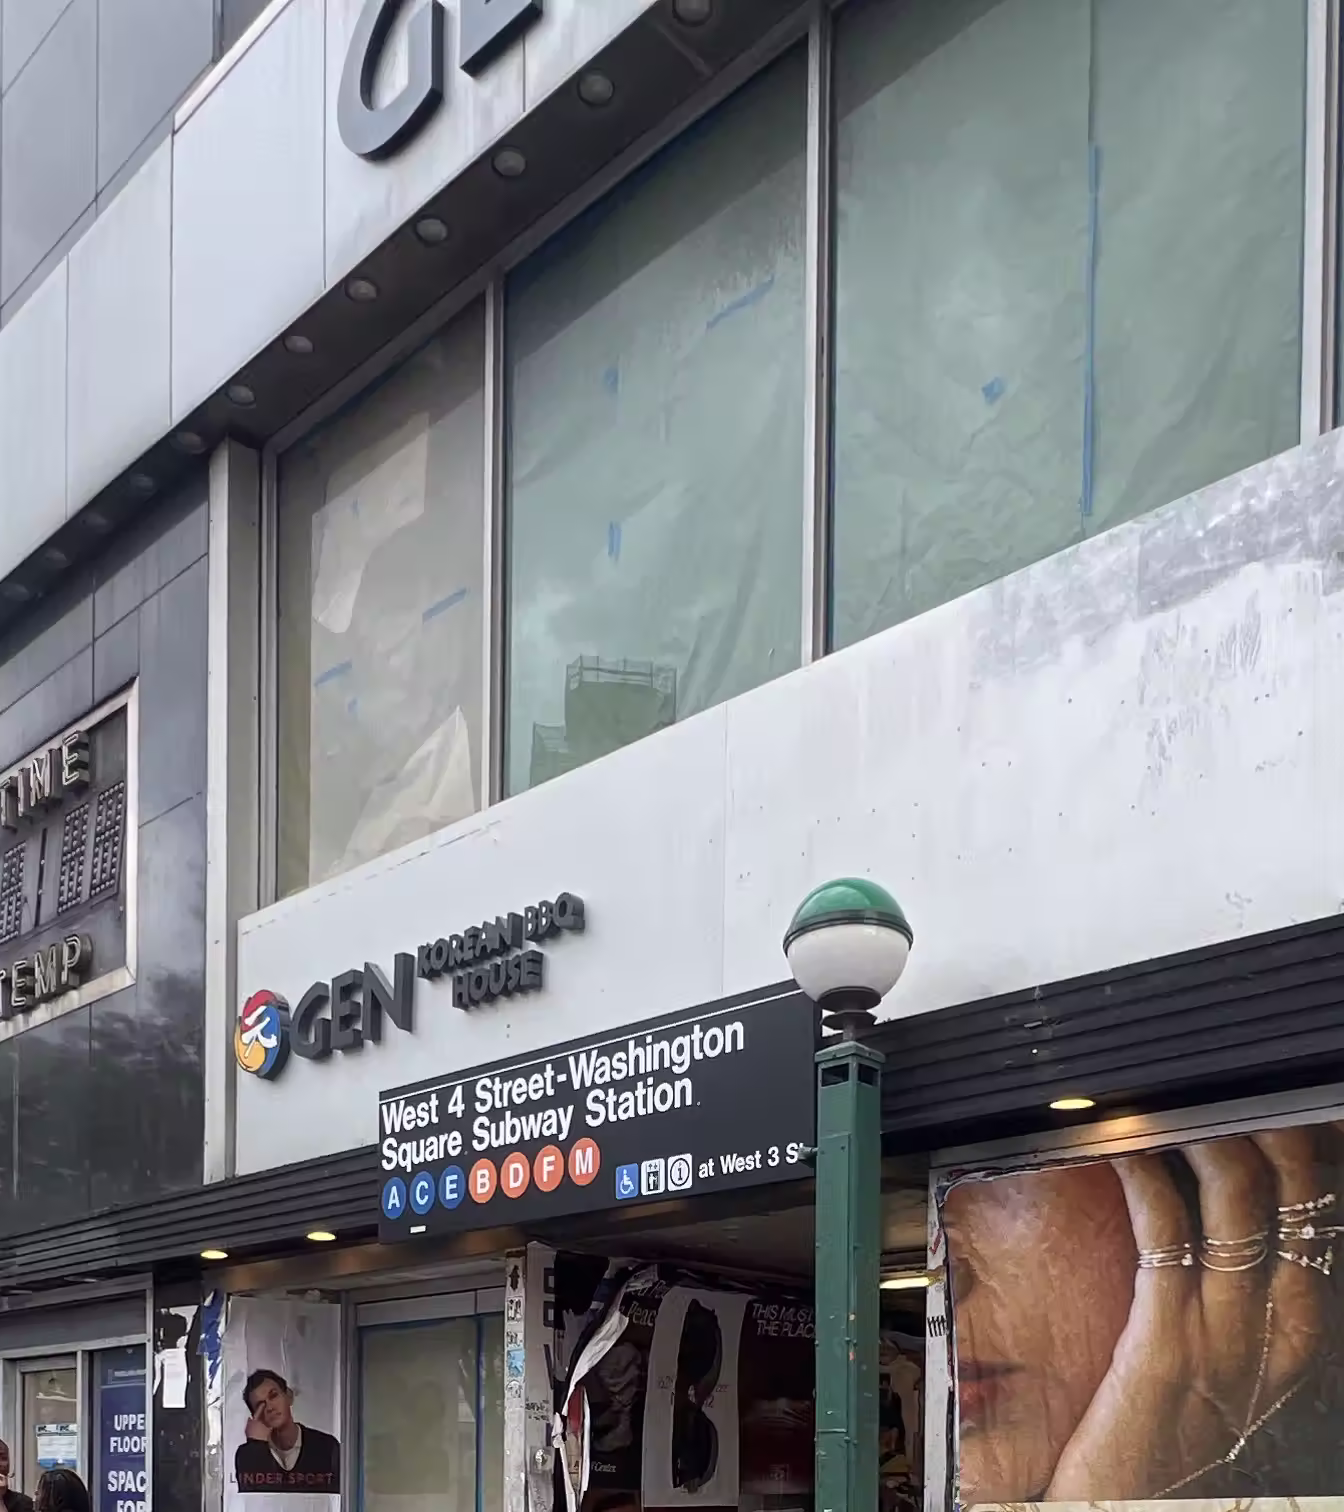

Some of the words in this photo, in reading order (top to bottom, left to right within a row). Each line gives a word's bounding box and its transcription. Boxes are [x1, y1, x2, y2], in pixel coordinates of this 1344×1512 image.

[417, 912, 524, 980] KOREAN
[524, 892, 586, 943] BBQ
[452, 950, 544, 1011] HOUSE
[290, 952, 416, 1060] GEN
[380, 1095, 439, 1134] West
[447, 1086, 465, 1118] 4
[474, 1021, 744, 1115] Street-Washington
[381, 1129, 462, 1173] Square
[472, 1103, 574, 1152] Subway
[585, 1077, 692, 1127] Station
[387, 1186, 401, 1210] A
[415, 1180, 429, 1205] C
[445, 1174, 459, 1199] E
[475, 1168, 490, 1193] B
[508, 1162, 524, 1188] D
[543, 1156, 555, 1182] F
[574, 1148, 593, 1176] M
[698, 1162, 716, 1178] at
[719, 1151, 762, 1173] West
[767, 1146, 780, 1167] 3
[627, 1301, 656, 1327] Peac
[752, 1303, 778, 1319] THIS
[757, 1320, 782, 1337] THE
[783, 1321, 815, 1339] PLAC
[114, 1413, 145, 1431] UPPE
[108, 1470, 147, 1492] SPAC
